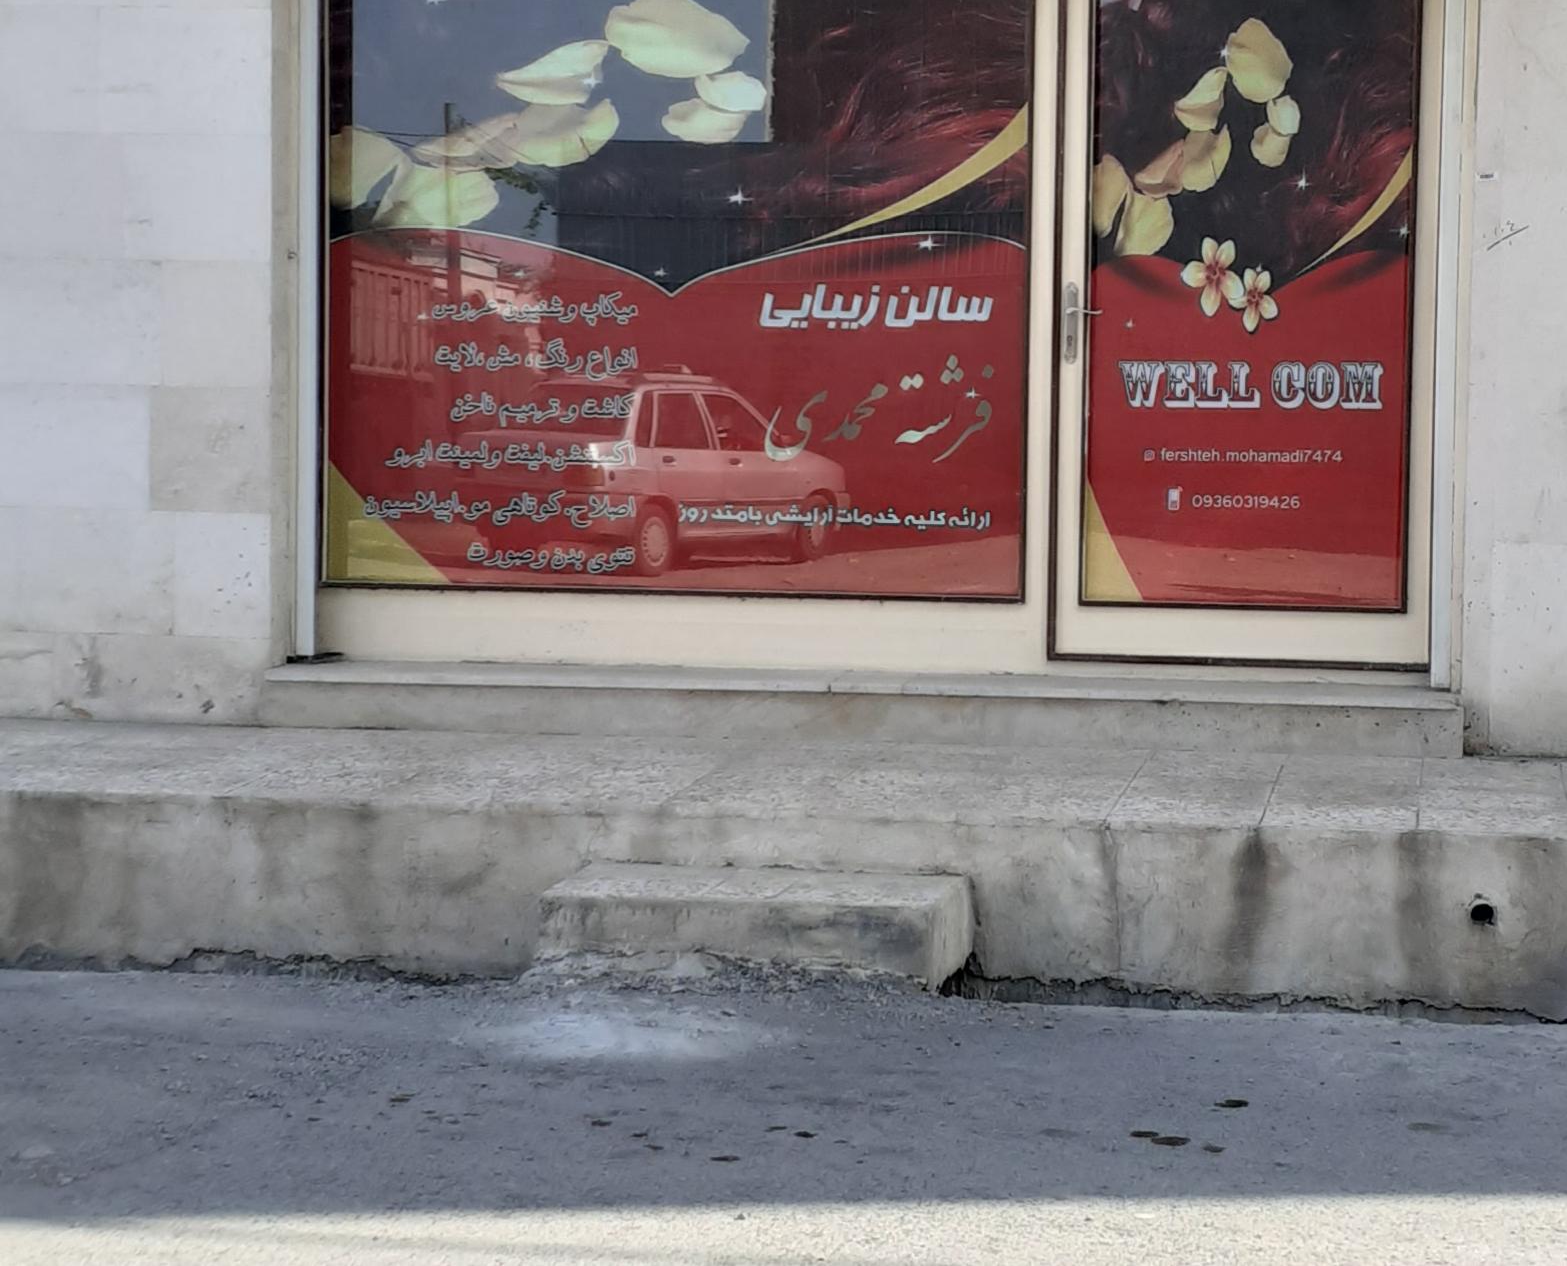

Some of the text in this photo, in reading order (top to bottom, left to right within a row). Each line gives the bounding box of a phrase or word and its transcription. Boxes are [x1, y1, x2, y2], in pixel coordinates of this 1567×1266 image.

[579, 291, 638, 325] میکاپ
[758, 283, 994, 329] سالن زیبایی
[485, 344, 520, 371] مش
[585, 346, 639, 380] انواع
[1119, 360, 1384, 410] WELL COM
[449, 391, 497, 422] ناخن
[498, 397, 560, 428] ترمیم
[581, 392, 636, 419] کاشت
[763, 354, 995, 464] فرشته محمدی
[384, 439, 433, 468] ابرو
[1160, 447, 1344, 464] fershteh.mohamadi7474
[492, 490, 567, 526] کوتاهی
[677, 504, 708, 523] روز
[1191, 493, 1301, 510] 09360319426
[835, 507, 902, 526] خدمات
[903, 510, 946, 530] کلیه
[948, 506, 991, 530] ارائه
[550, 547, 585, 570] بدن
